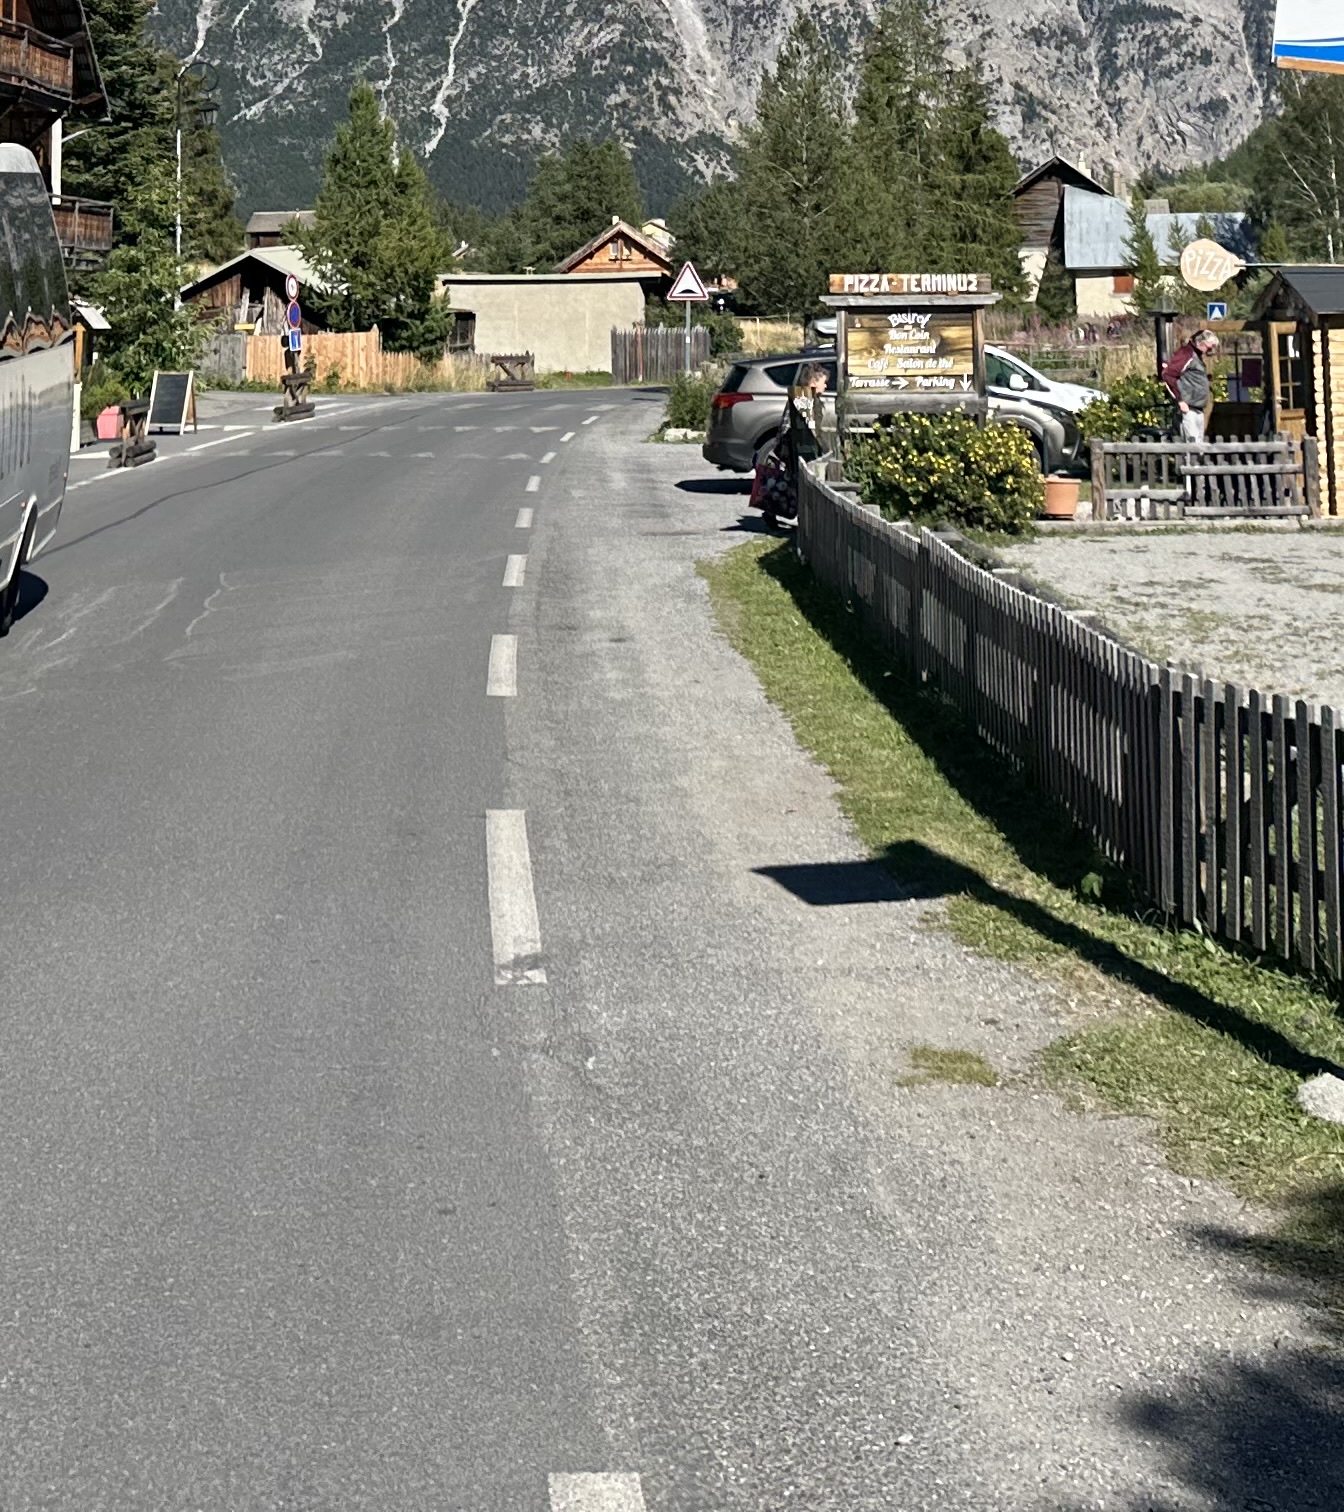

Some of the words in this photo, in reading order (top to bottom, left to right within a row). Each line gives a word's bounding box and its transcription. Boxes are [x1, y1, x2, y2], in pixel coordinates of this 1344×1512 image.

[844, 274, 890, 292] PIZZA
[901, 273, 978, 292] TERMINUS
[883, 342, 937, 355] Restaurant
[897, 358, 924, 369] Salon
[925, 358, 937, 369] de
[849, 376, 890, 388] Terrasse
[914, 375, 956, 390] Parking
